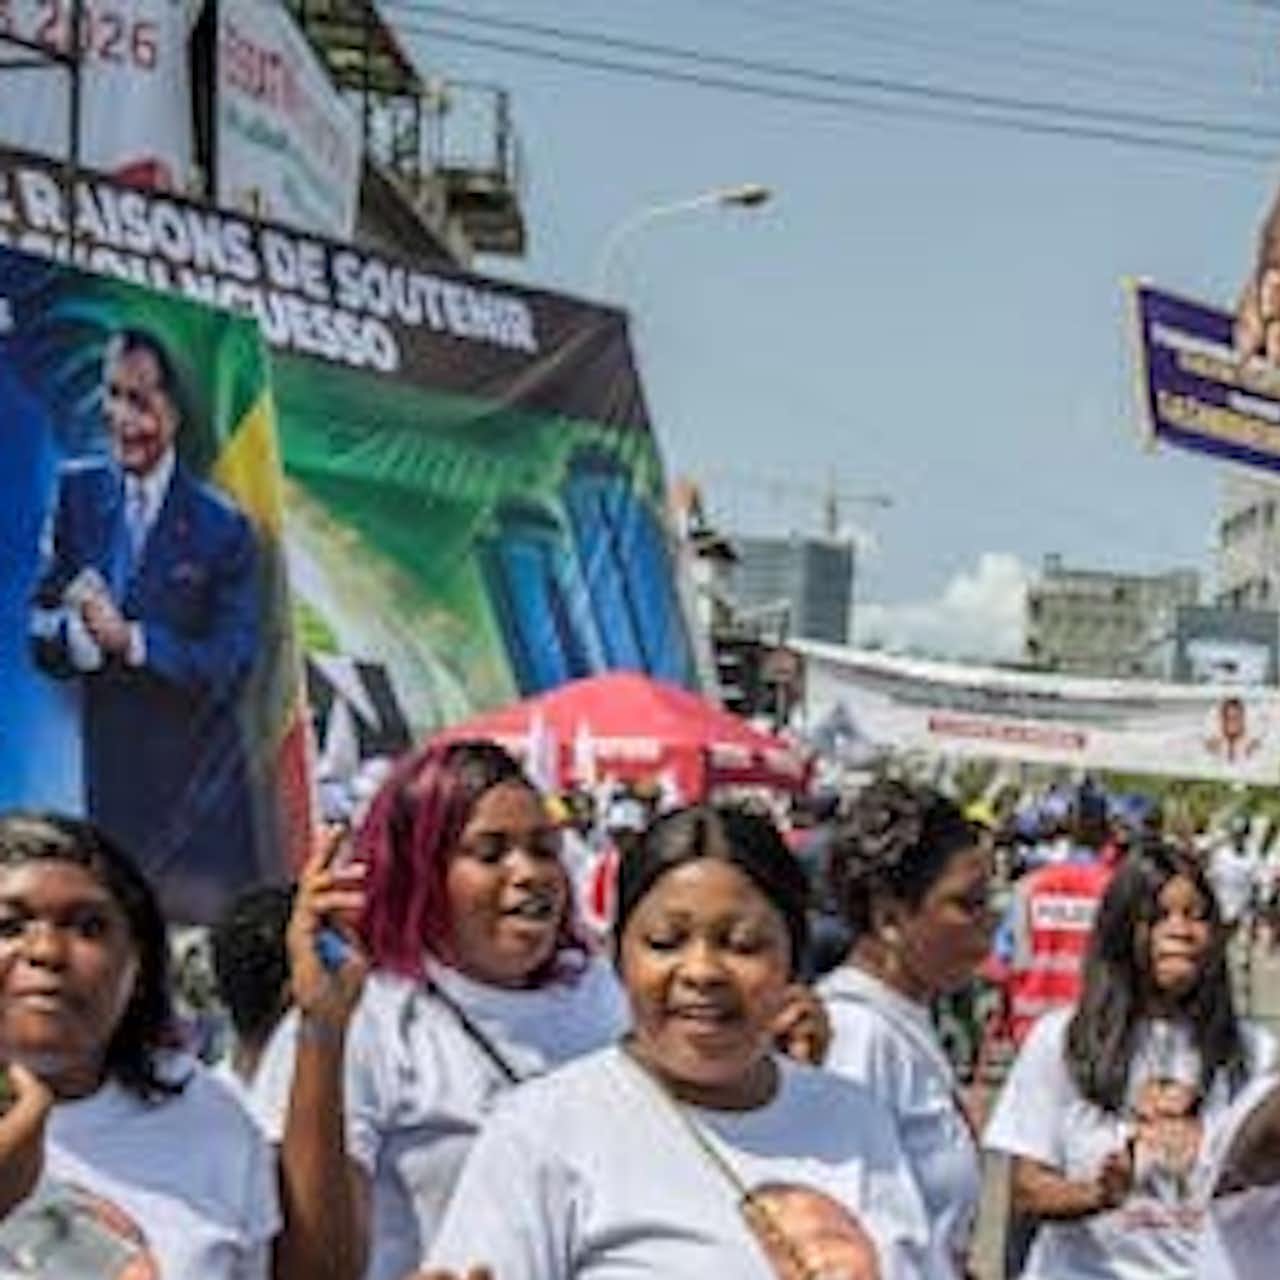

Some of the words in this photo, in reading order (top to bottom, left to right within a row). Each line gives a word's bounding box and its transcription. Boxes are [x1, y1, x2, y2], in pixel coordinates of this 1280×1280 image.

[17, 168, 259, 281] RAISONS
[261, 230, 329, 300] DE
[331, 251, 538, 353] SOUTENIR
